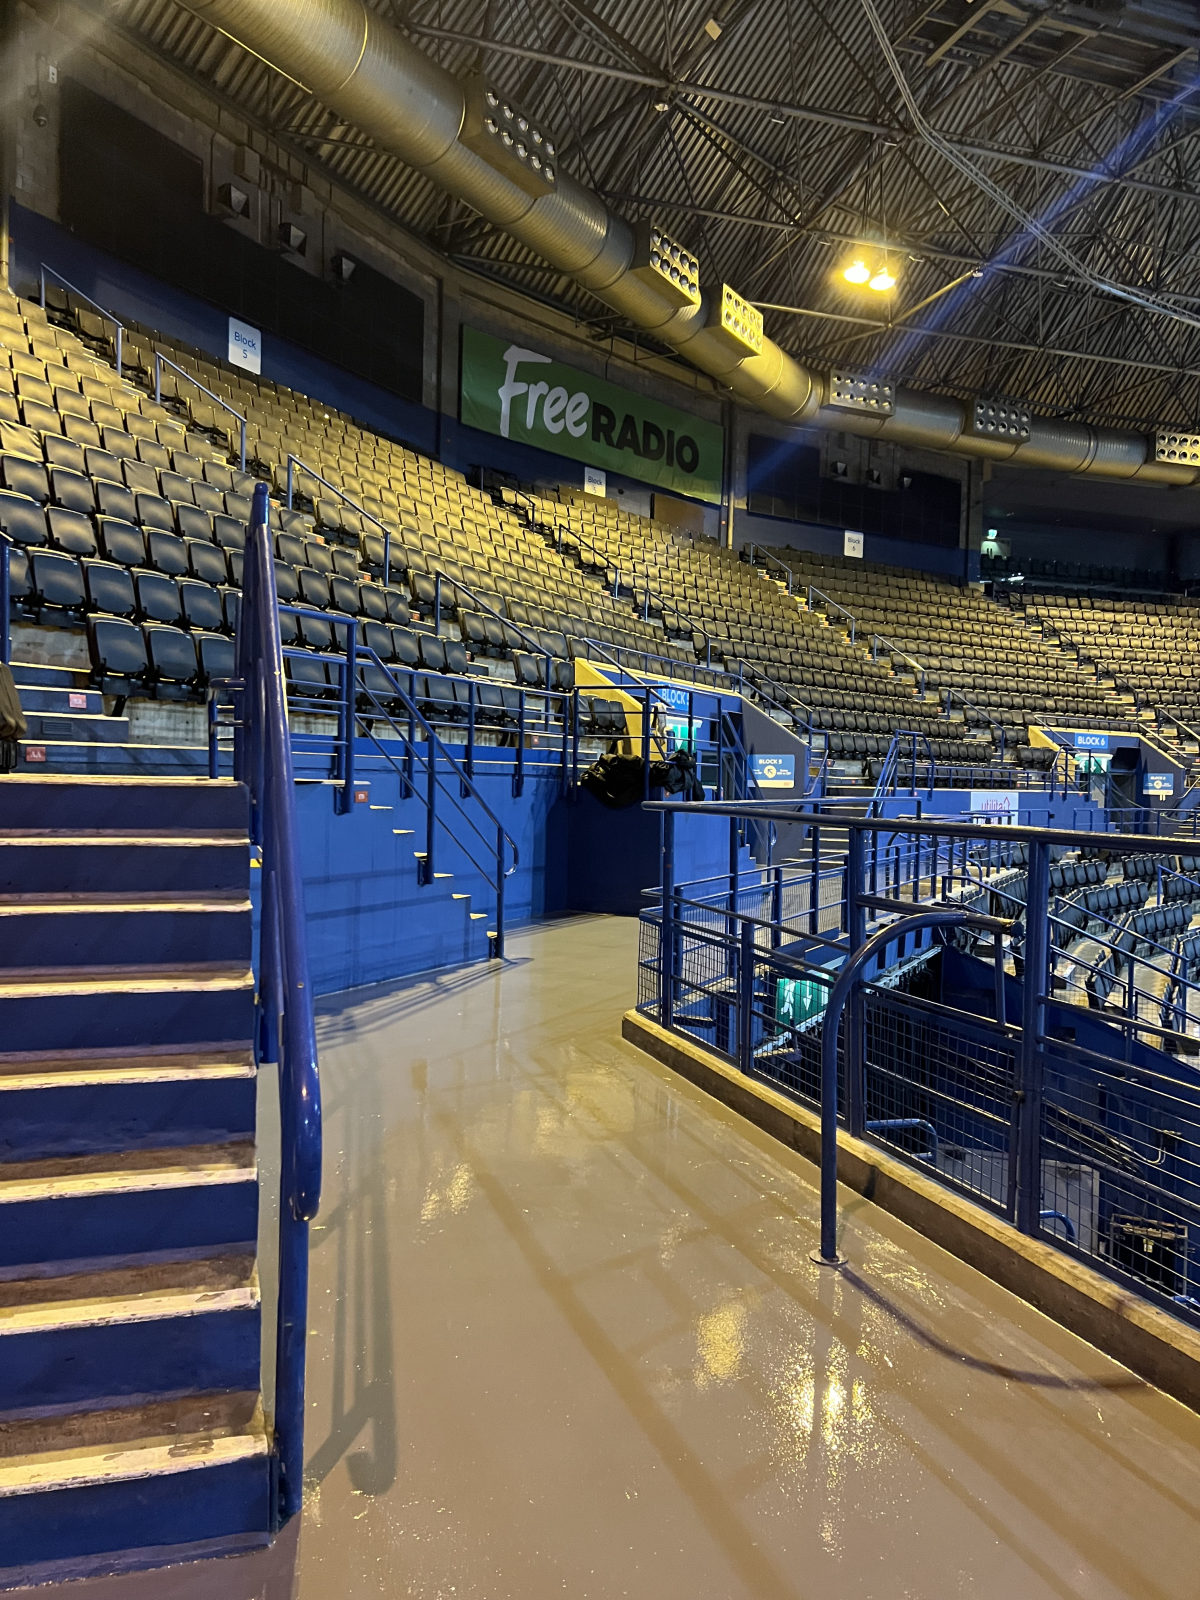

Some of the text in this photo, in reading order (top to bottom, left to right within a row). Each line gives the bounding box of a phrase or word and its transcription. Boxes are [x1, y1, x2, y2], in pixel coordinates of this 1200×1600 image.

[234, 331, 256, 350] Block
[242, 349, 248, 359] 5
[498, 345, 700, 474] Free RADIO
[661, 688, 686, 705] BLOCK
[1077, 735, 1106, 746] BLOCK 6
